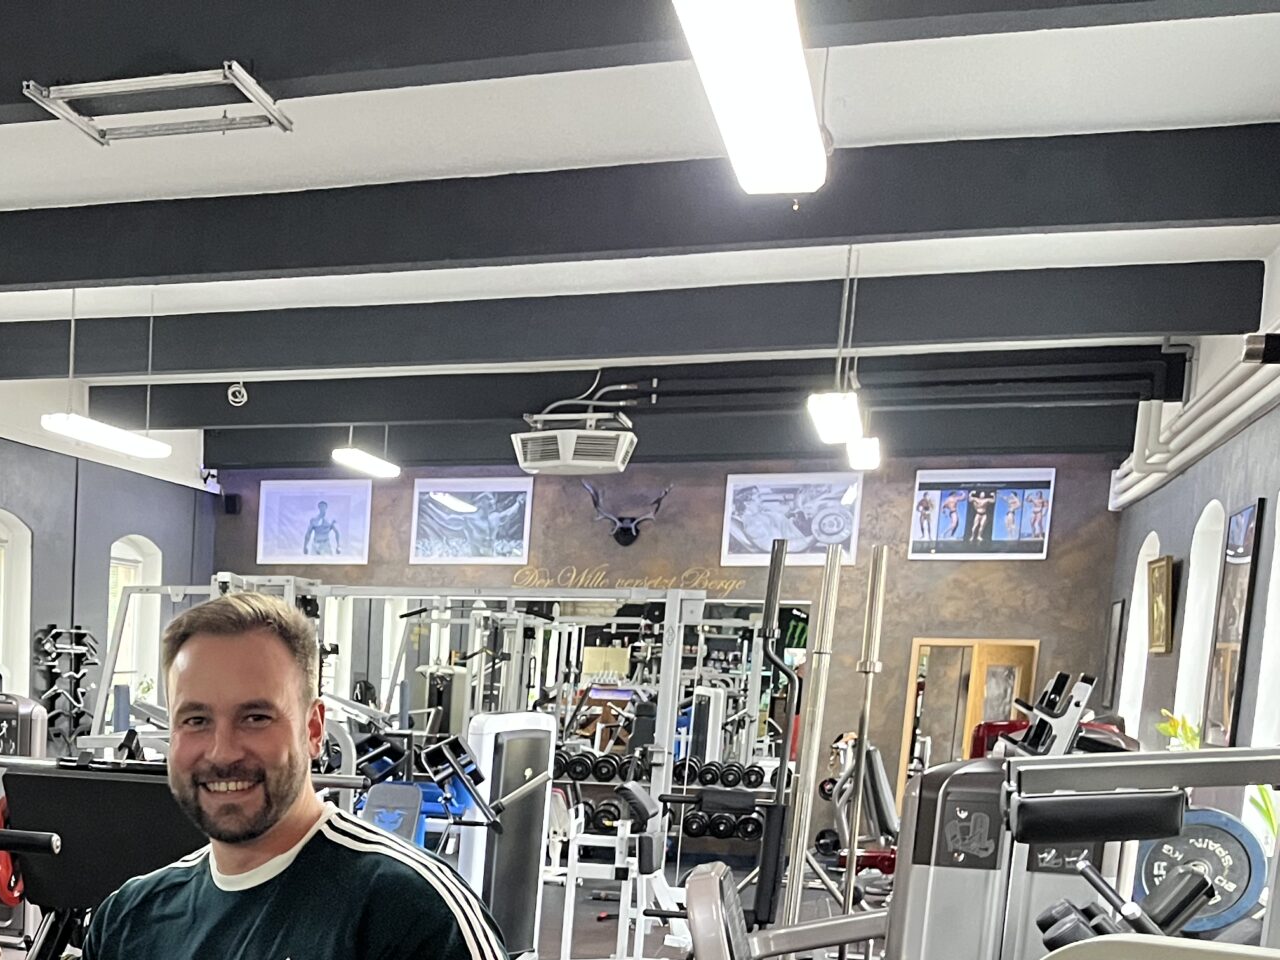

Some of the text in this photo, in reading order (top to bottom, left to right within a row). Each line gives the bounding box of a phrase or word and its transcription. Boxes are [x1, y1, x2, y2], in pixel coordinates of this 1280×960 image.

[513, 567, 554, 589] Der
[558, 563, 609, 588] Wille
[680, 567, 746, 599] Berge
